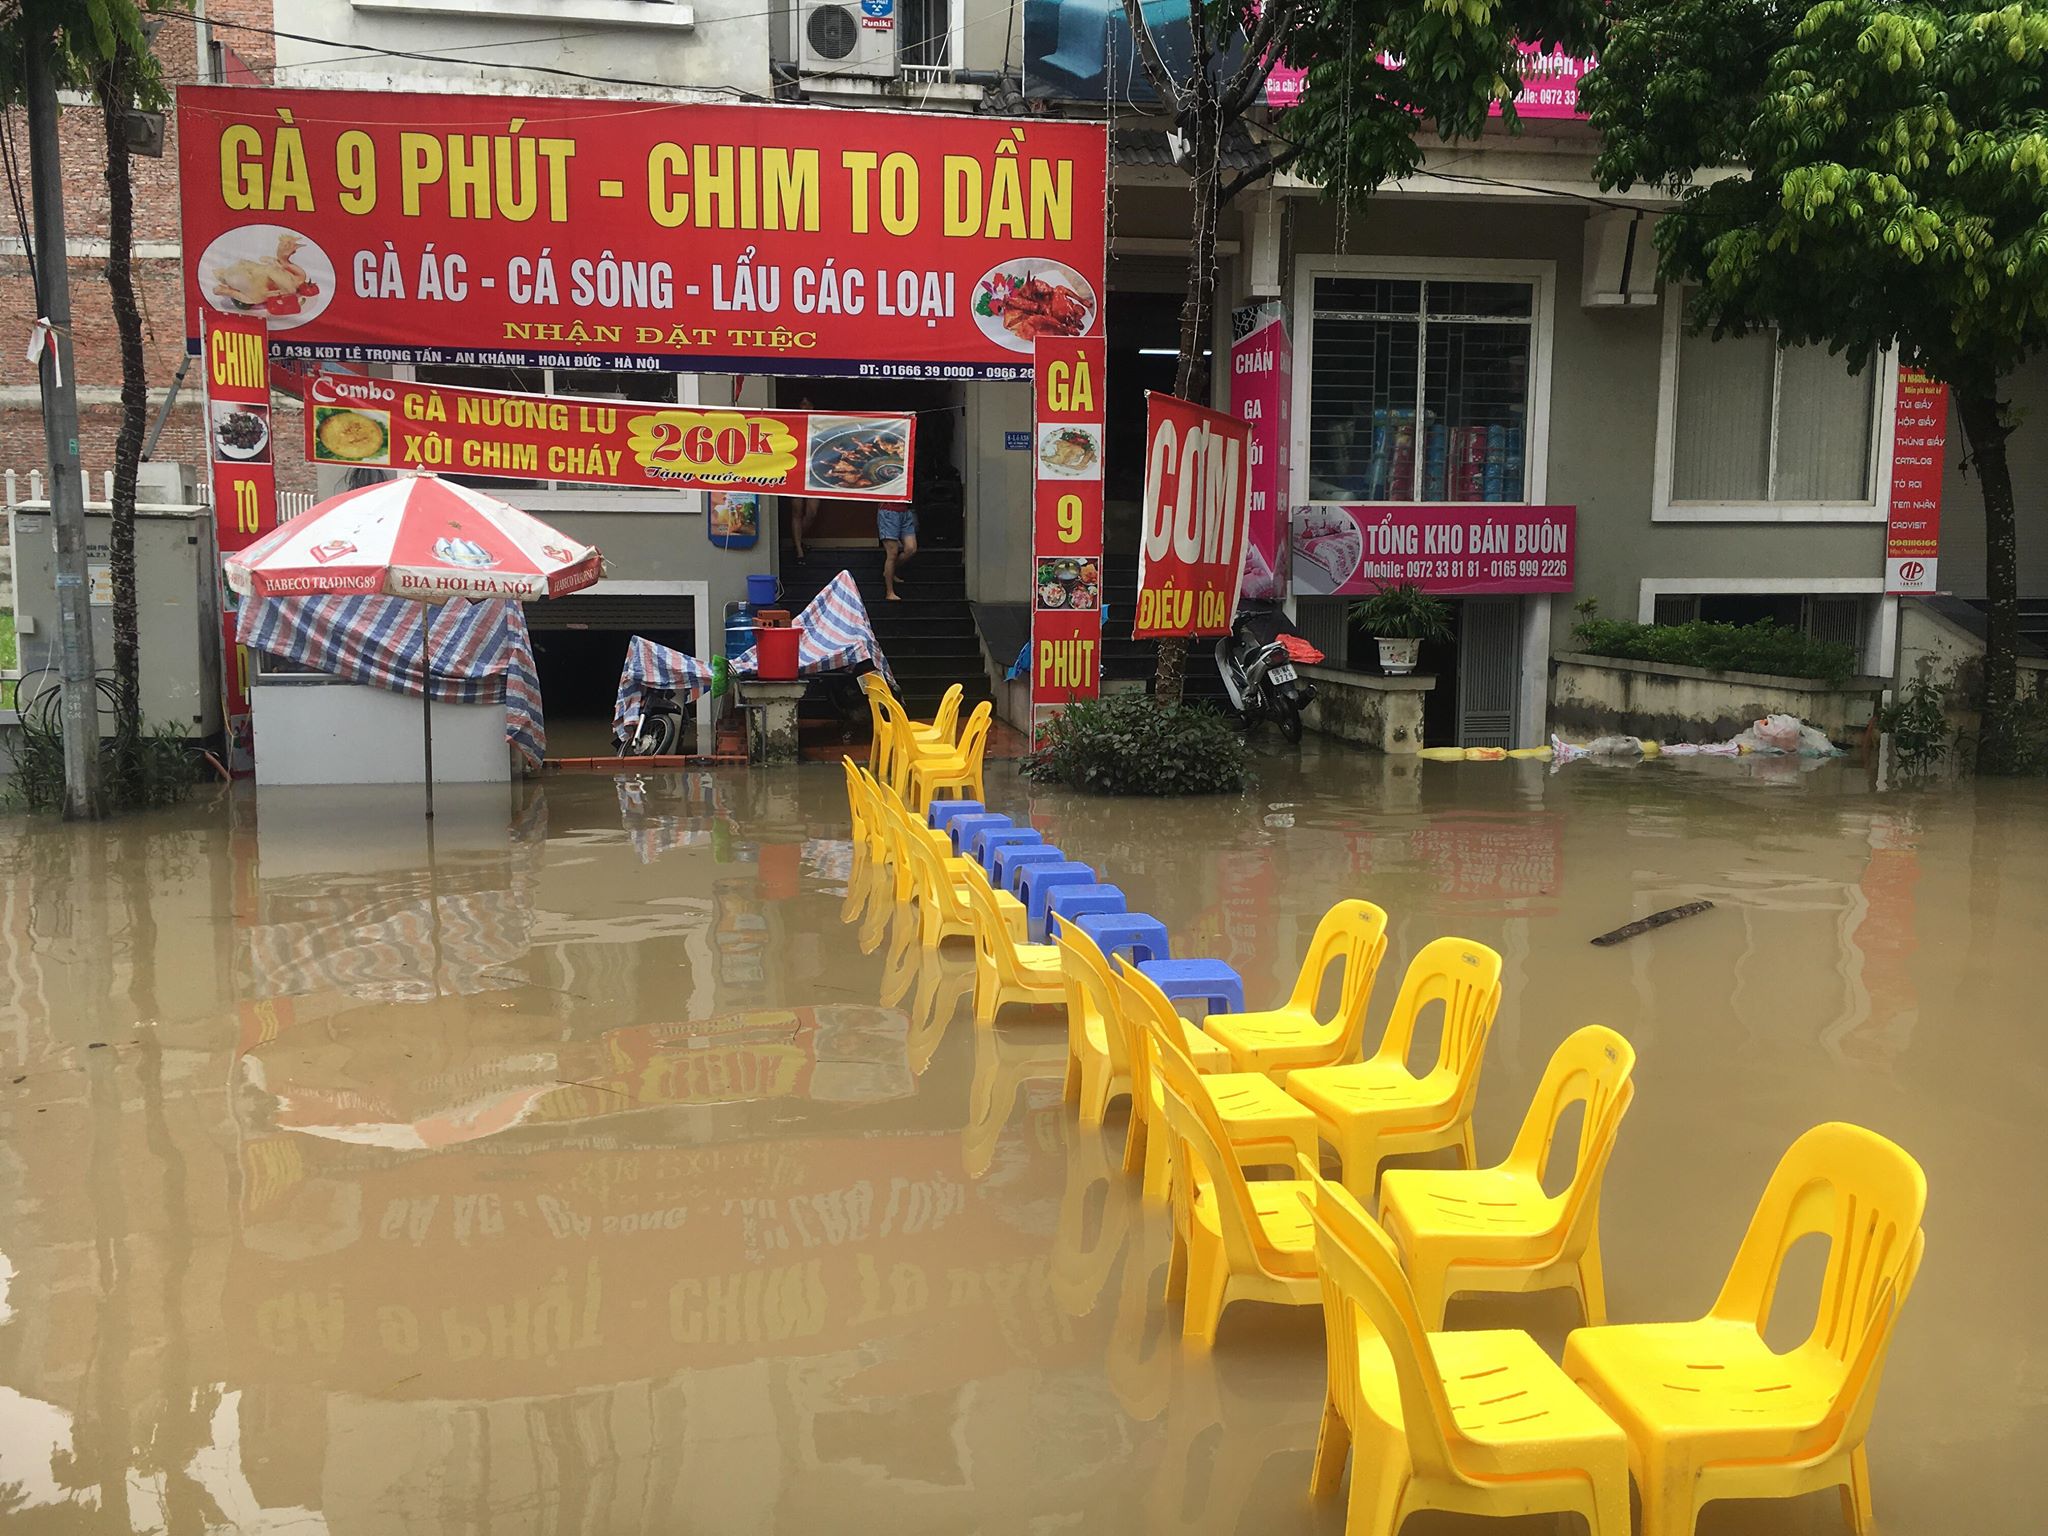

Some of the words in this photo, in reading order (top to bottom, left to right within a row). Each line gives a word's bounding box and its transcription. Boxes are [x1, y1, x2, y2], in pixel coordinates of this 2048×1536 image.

[863, 19, 891, 27] Funiki
[1540, 89, 1562, 104] 0972
[1564, 90, 1576, 105] 33
[220, 108, 315, 213] GÀ
[335, 130, 377, 216] 9
[400, 118, 576, 223] PHÚT
[599, 180, 623, 199] -
[647, 141, 821, 233] CHIM
[841, 150, 920, 237] TO
[943, 127, 1074, 241] DẦN
[353, 240, 403, 299] GÀ
[417, 242, 469, 302] ÁC
[481, 277, 496, 288] -
[508, 247, 559, 306] CÁ
[571, 249, 674, 309] SÔNG
[685, 284, 699, 295] -
[712, 245, 780, 313] LẨU
[793, 258, 866, 316] CÁC
[877, 269, 955, 328] LOẠI
[502, 319, 623, 346] NHẬN
[636, 322, 717, 350] ĐẶT
[727, 325, 818, 350] TIỆC
[212, 329, 265, 389] CHIM
[268, 343, 281, 357] Ô
[285, 346, 311, 358] A38
[315, 347, 341, 359] KĐT
[346, 346, 361, 360] LÊ
[365, 348, 411, 363] TRỌNG
[415, 347, 442, 362] TẤN
[456, 352, 475, 364] AN
[479, 351, 525, 365] KHÁNH
[538, 353, 570, 367] HOÀI
[574, 354, 602, 368] ĐỨC
[614, 356, 633, 369] HÀ
[636, 357, 660, 371] NỘI
[859, 364, 879, 376] ĐT:
[882, 364, 921, 377] 01666
[924, 366, 940, 377] 39
[943, 366, 974, 378] 0000
[986, 367, 1016, 379] 0966
[1235, 347, 1273, 375] CHĂN
[311, 376, 395, 403] Combo
[1047, 350, 1094, 412] GÀ
[403, 389, 446, 423] GÀ
[457, 396, 568, 432] NƯỚNG
[580, 406, 617, 435] LU
[1244, 399, 1262, 420] GA
[403, 431, 452, 465] XÔI
[462, 439, 538, 471] CHIM
[548, 443, 622, 477] CHÁY
[651, 422, 773, 466] 260k
[1251, 438, 1263, 466] ỐI
[1895, 456, 1933, 465] CATALOG
[645, 466, 695, 481] Tặng
[700, 471, 741, 482] nước
[747, 475, 787, 487] ngọt
[1147, 418, 1240, 566] CƠM
[1892, 501, 1911, 509] TEM
[233, 480, 259, 534] TO
[1056, 494, 1083, 544] 9
[1367, 513, 1419, 555] TỔNG
[1425, 523, 1462, 554] KHO
[1470, 518, 1508, 554] BÁN
[1515, 518, 1567, 554] BUÔN
[1363, 560, 1404, 578] Mobile:
[1407, 561, 1433, 578] 0972
[1435, 561, 1450, 578] 33
[1451, 560, 1464, 578] 81
[1467, 560, 1480, 578] 81
[1491, 560, 1517, 578] 0165
[1520, 559, 1539, 577] 999
[1541, 559, 1567, 577] 2226
[265, 577, 310, 592] HABECO
[312, 575, 376, 589] TRADING89
[401, 575, 432, 589] BIA
[436, 577, 468, 591] HƠI
[474, 577, 498, 592] HÀ
[502, 579, 533, 597] NỘI
[1138, 575, 1193, 630] ĐIỀU
[1039, 630, 1094, 688] PHÚT
